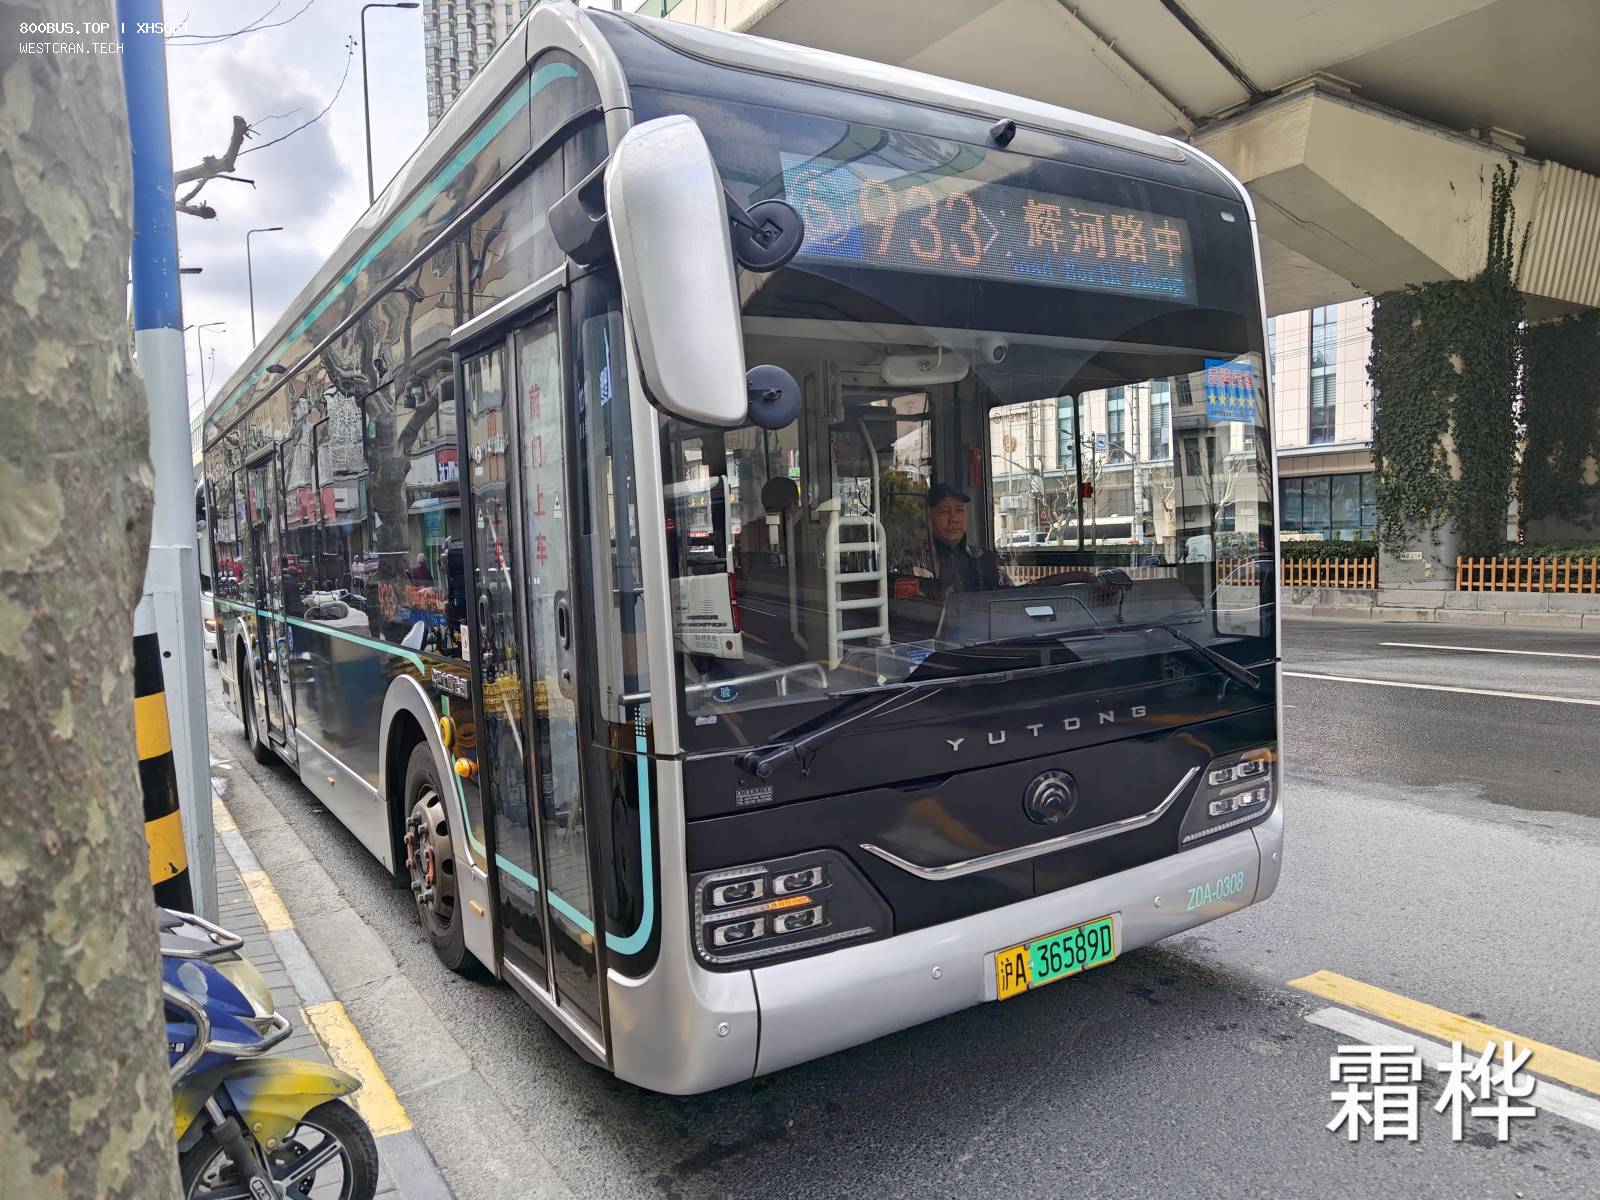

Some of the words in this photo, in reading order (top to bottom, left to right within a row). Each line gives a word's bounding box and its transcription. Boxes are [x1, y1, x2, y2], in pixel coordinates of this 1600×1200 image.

[859, 176, 982, 269] 933
[1023, 198, 1182, 267] 辉河路中
[528, 383, 548, 566] 前门上车
[946, 704, 1147, 752] YUTONG
